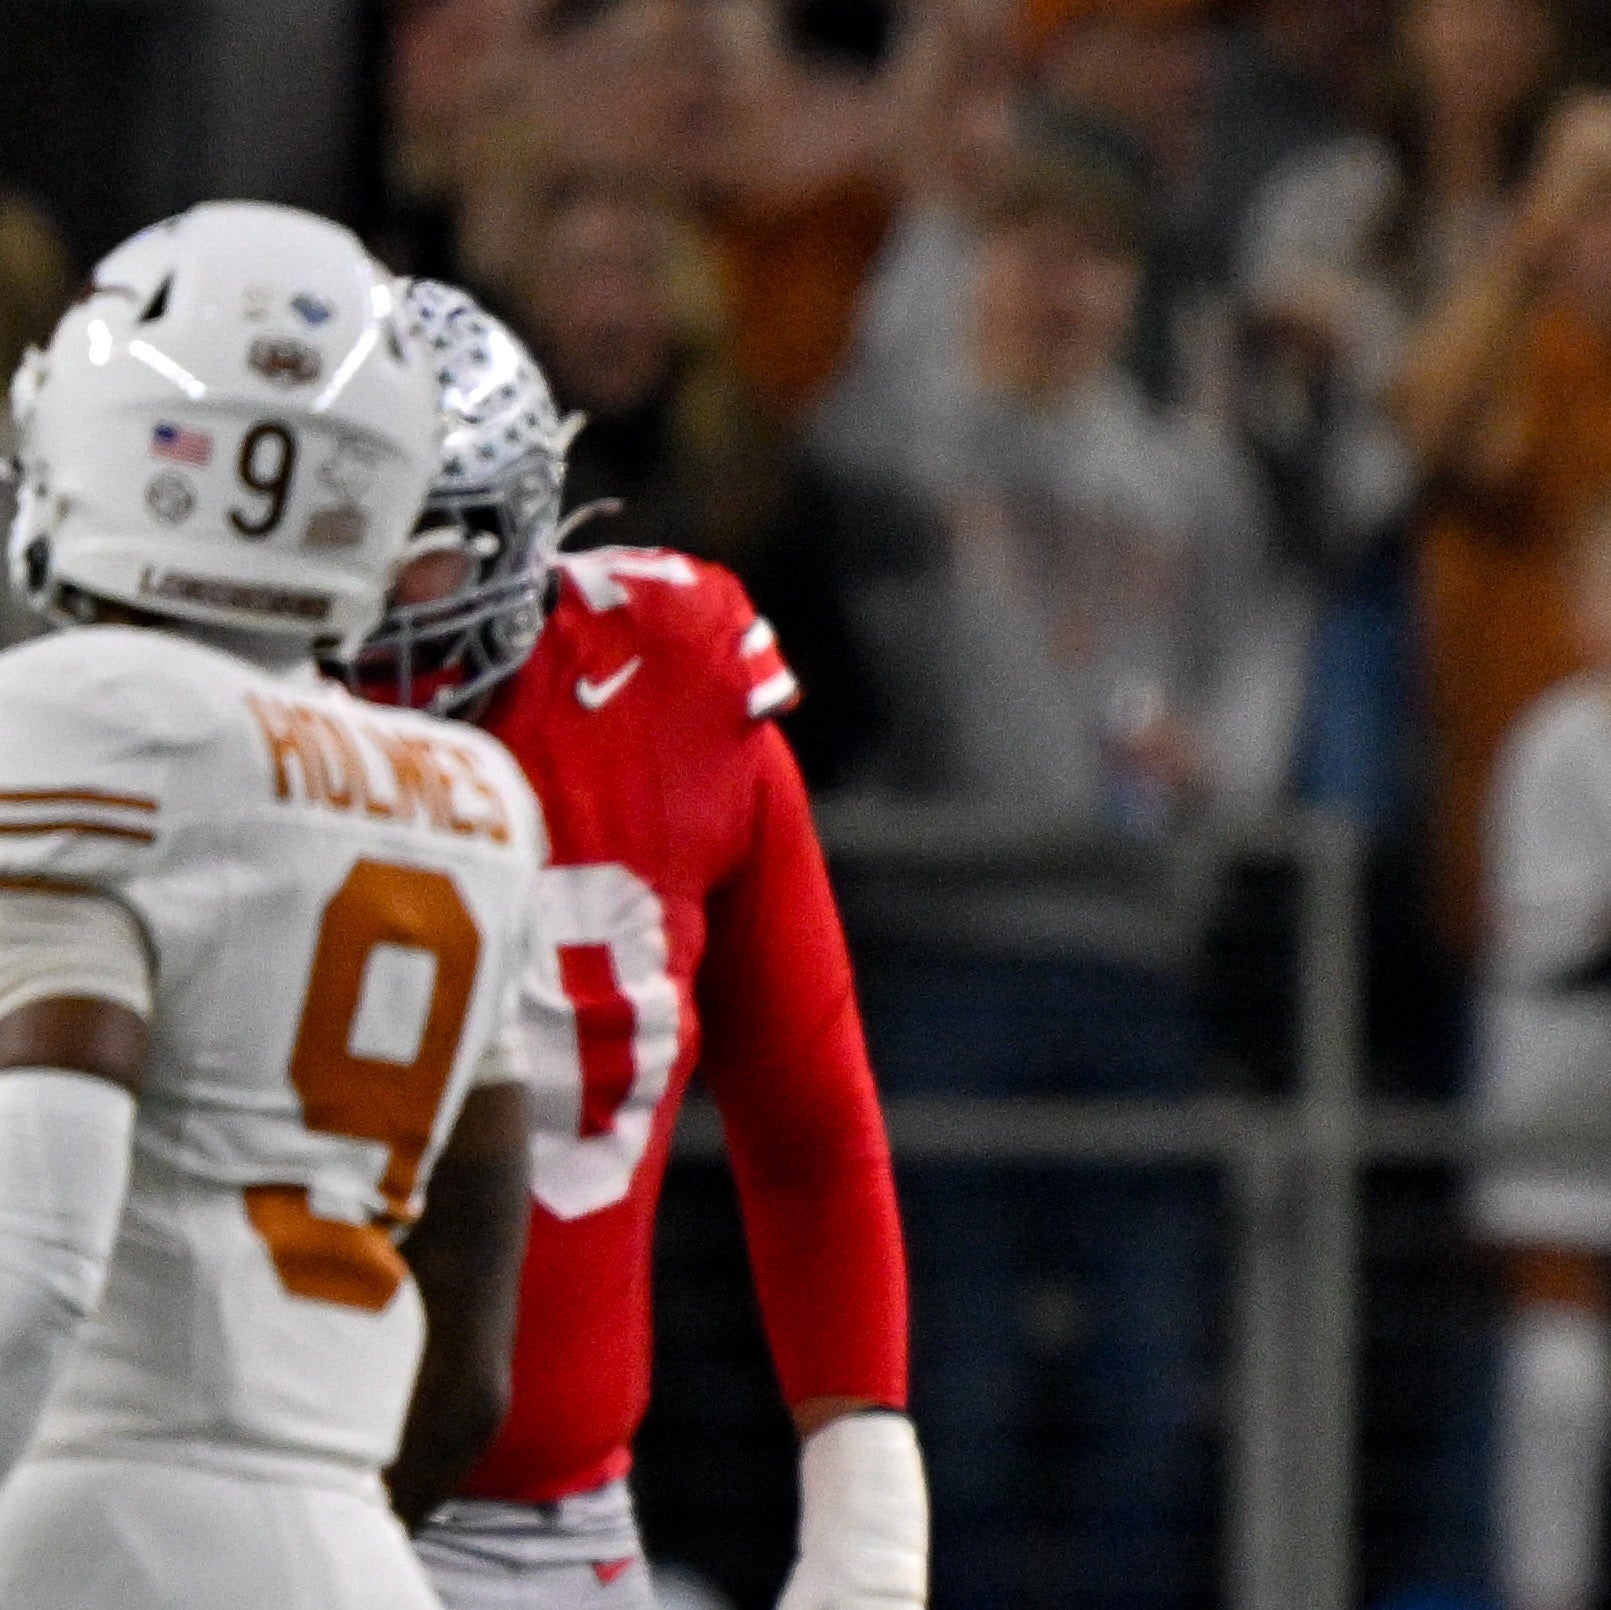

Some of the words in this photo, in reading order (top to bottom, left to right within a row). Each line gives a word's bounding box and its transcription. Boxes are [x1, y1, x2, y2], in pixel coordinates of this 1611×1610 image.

[229, 420, 296, 537] 9
[248, 694, 514, 842] HOLMES
[244, 858, 483, 1312] 9
